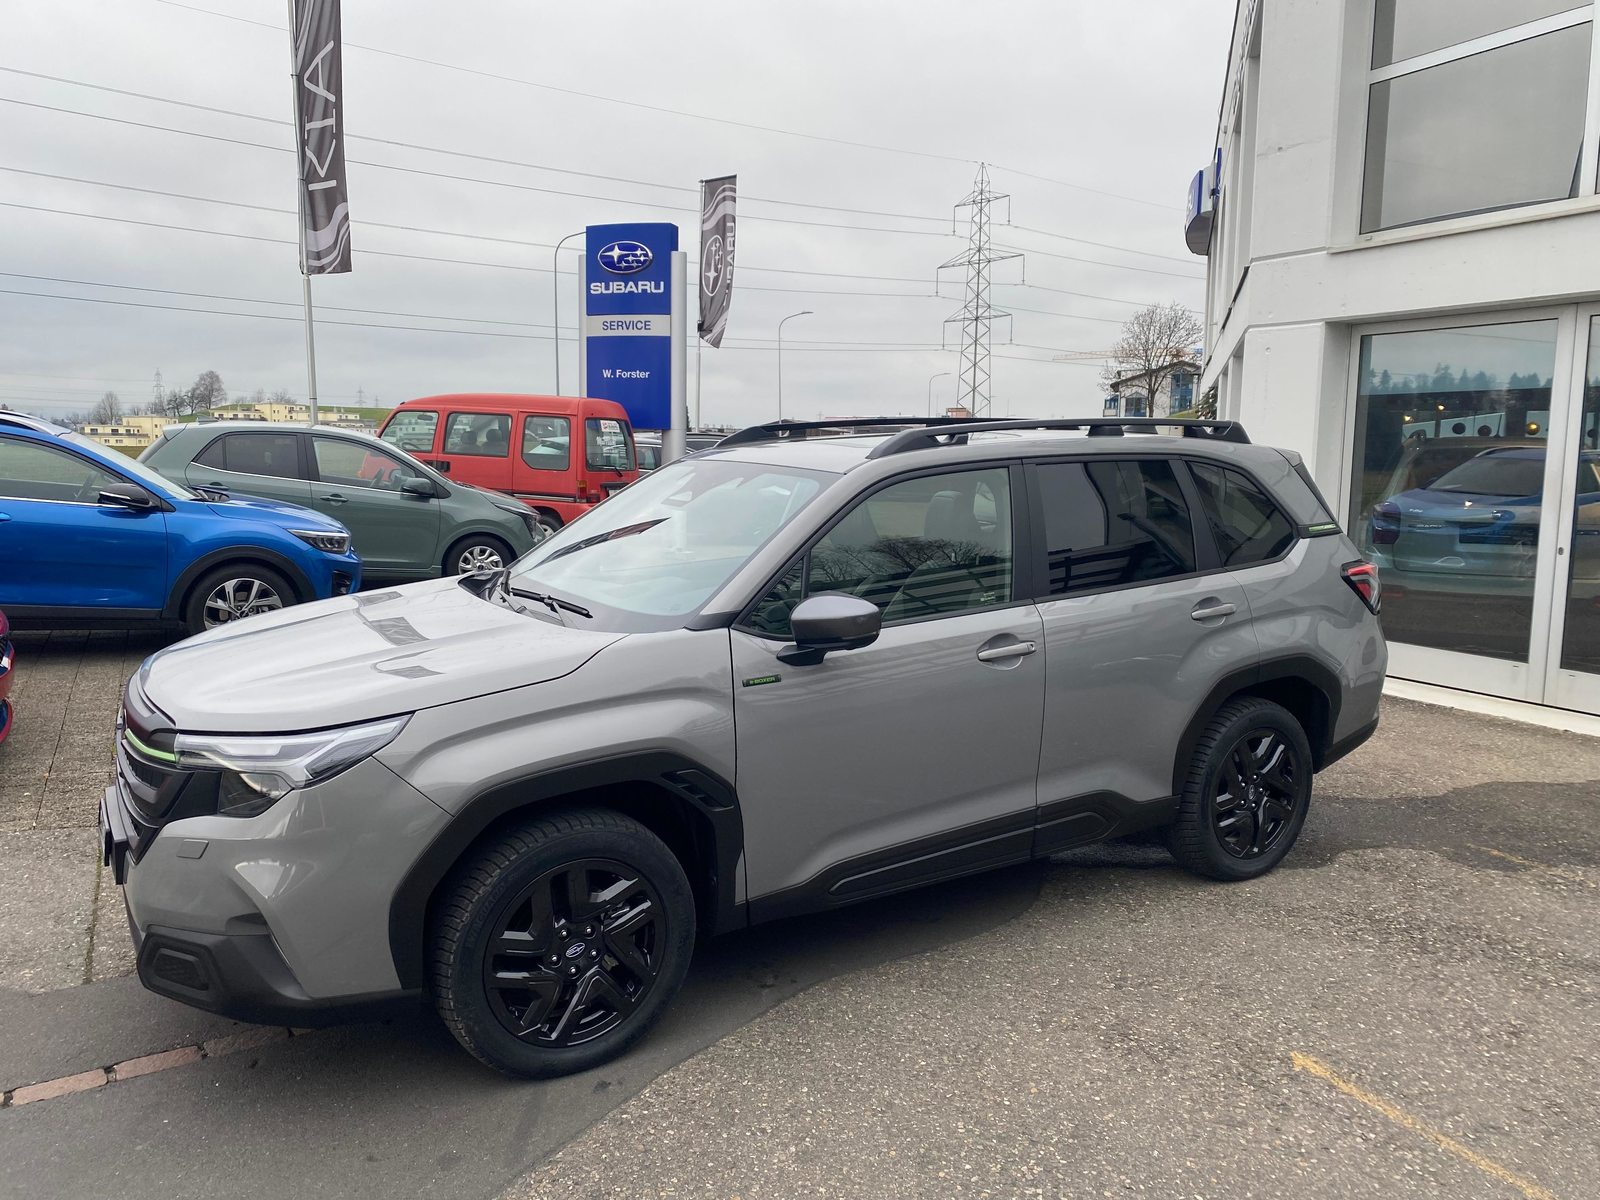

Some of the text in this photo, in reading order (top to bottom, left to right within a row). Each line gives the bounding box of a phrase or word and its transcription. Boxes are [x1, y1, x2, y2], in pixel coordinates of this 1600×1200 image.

[303, 40, 337, 191] KIA
[723, 222, 735, 306] BARU
[590, 281, 665, 294] SUBARU
[602, 320, 652, 331] SERVICE
[602, 368, 650, 379] W. Forster
